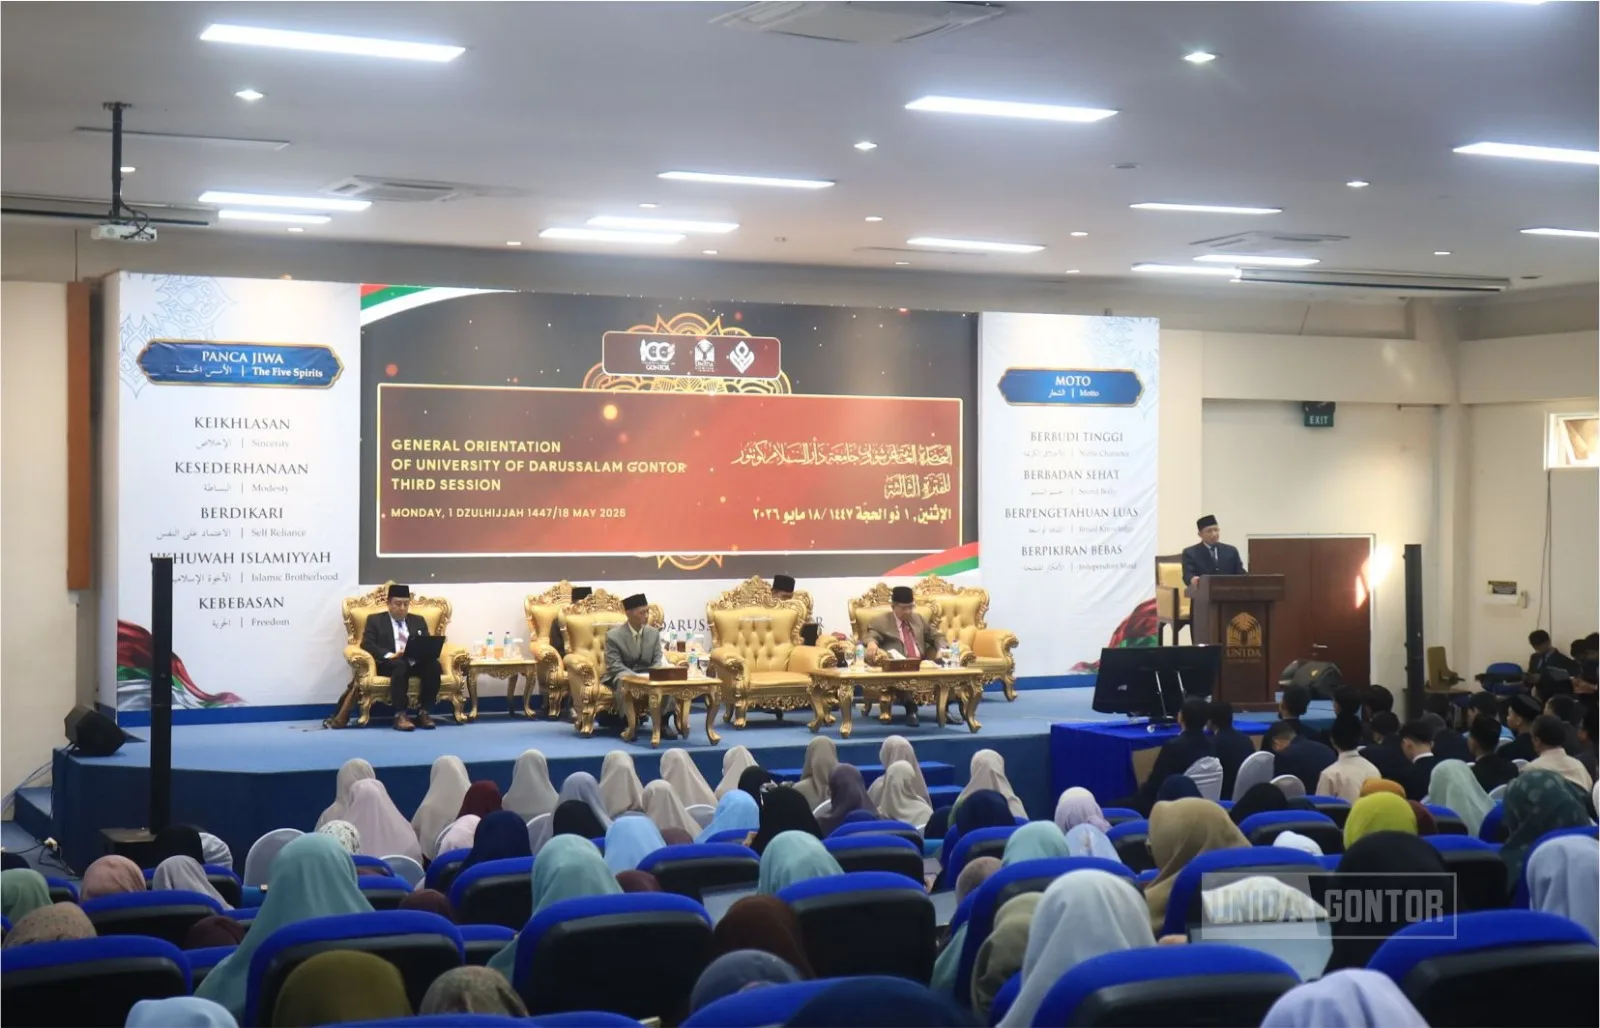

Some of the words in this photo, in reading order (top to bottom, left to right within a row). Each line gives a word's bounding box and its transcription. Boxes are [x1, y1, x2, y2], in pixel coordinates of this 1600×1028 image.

[202, 351, 248, 362] PANCA
[252, 352, 284, 365] JIWA
[252, 366, 270, 376] The
[272, 367, 292, 377] Five
[293, 368, 323, 379] Spirits
[1055, 375, 1091, 386] MOTO
[1079, 389, 1099, 397] Motto
[194, 417, 290, 429] KEIKHLASAN
[1309, 415, 1328, 425] EXIT
[1030, 432, 1078, 442] BERBUDI
[1083, 432, 1123, 442] TINGGI
[252, 439, 289, 449] Sincerity
[391, 439, 460, 452] GENERAL
[464, 440, 561, 453] ORIENTATION
[175, 461, 308, 474] KESEDERHANAAN
[391, 459, 412, 471] OF
[416, 459, 501, 472] UNIVERSITY
[505, 460, 524, 472] OF
[529, 460, 623, 473] DARUSSALAM
[627, 461, 687, 473] GONTOR
[1024, 469, 1082, 480] BERBADAN
[1086, 469, 1120, 480] SEHAT
[252, 484, 289, 494] Modesty
[391, 478, 435, 490] THIRD
[439, 479, 501, 491] SESSION
[201, 507, 283, 519] BERDIKARI
[391, 508, 445, 519] MONDAY,
[449, 508, 453, 518] 1
[457, 508, 524, 518] DZULHIJJAH
[528, 507, 569, 520] 1447/18
[572, 508, 596, 518] MAY
[599, 508, 626, 518] 2026
[904, 508, 909, 520] ١
[1005, 508, 1109, 519] BERPENGETAHUAN
[1112, 507, 1138, 518] LUAS
[251, 528, 268, 537] Self
[270, 528, 306, 537] Reliance
[1021, 546, 1087, 556] BERPIKIRAN
[1091, 545, 1122, 556] BEBAS
[240, 552, 331, 564] ISLAMIYYAH
[251, 573, 282, 582] Islamic
[285, 572, 339, 582] Brotherhood
[199, 597, 285, 610] KEBEBASAN
[251, 617, 290, 627] Freedom
[1226, 648, 1262, 657] UNIDA
